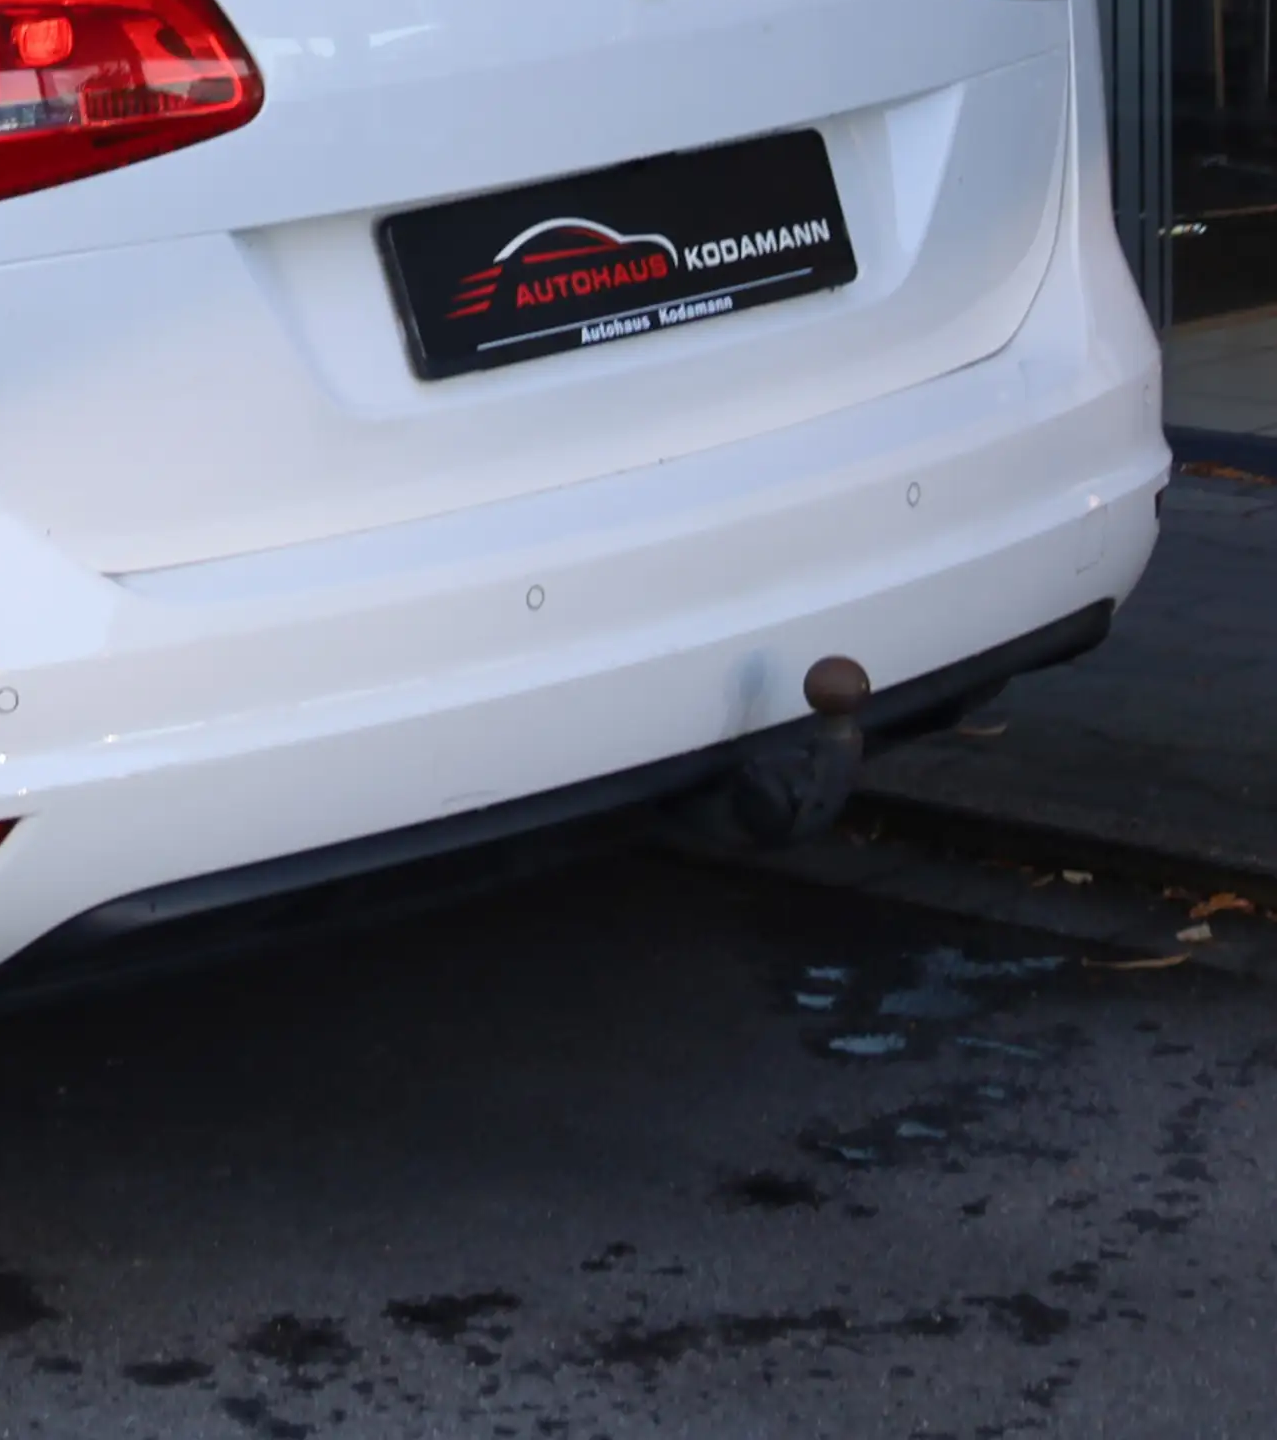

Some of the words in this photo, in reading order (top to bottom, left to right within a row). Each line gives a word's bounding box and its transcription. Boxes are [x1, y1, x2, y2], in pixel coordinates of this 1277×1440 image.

[514, 252, 669, 309] AUTOHAUS
[683, 218, 831, 271] KODAMANN
[580, 314, 651, 345] Autohaus
[658, 295, 734, 328] Kodamann
